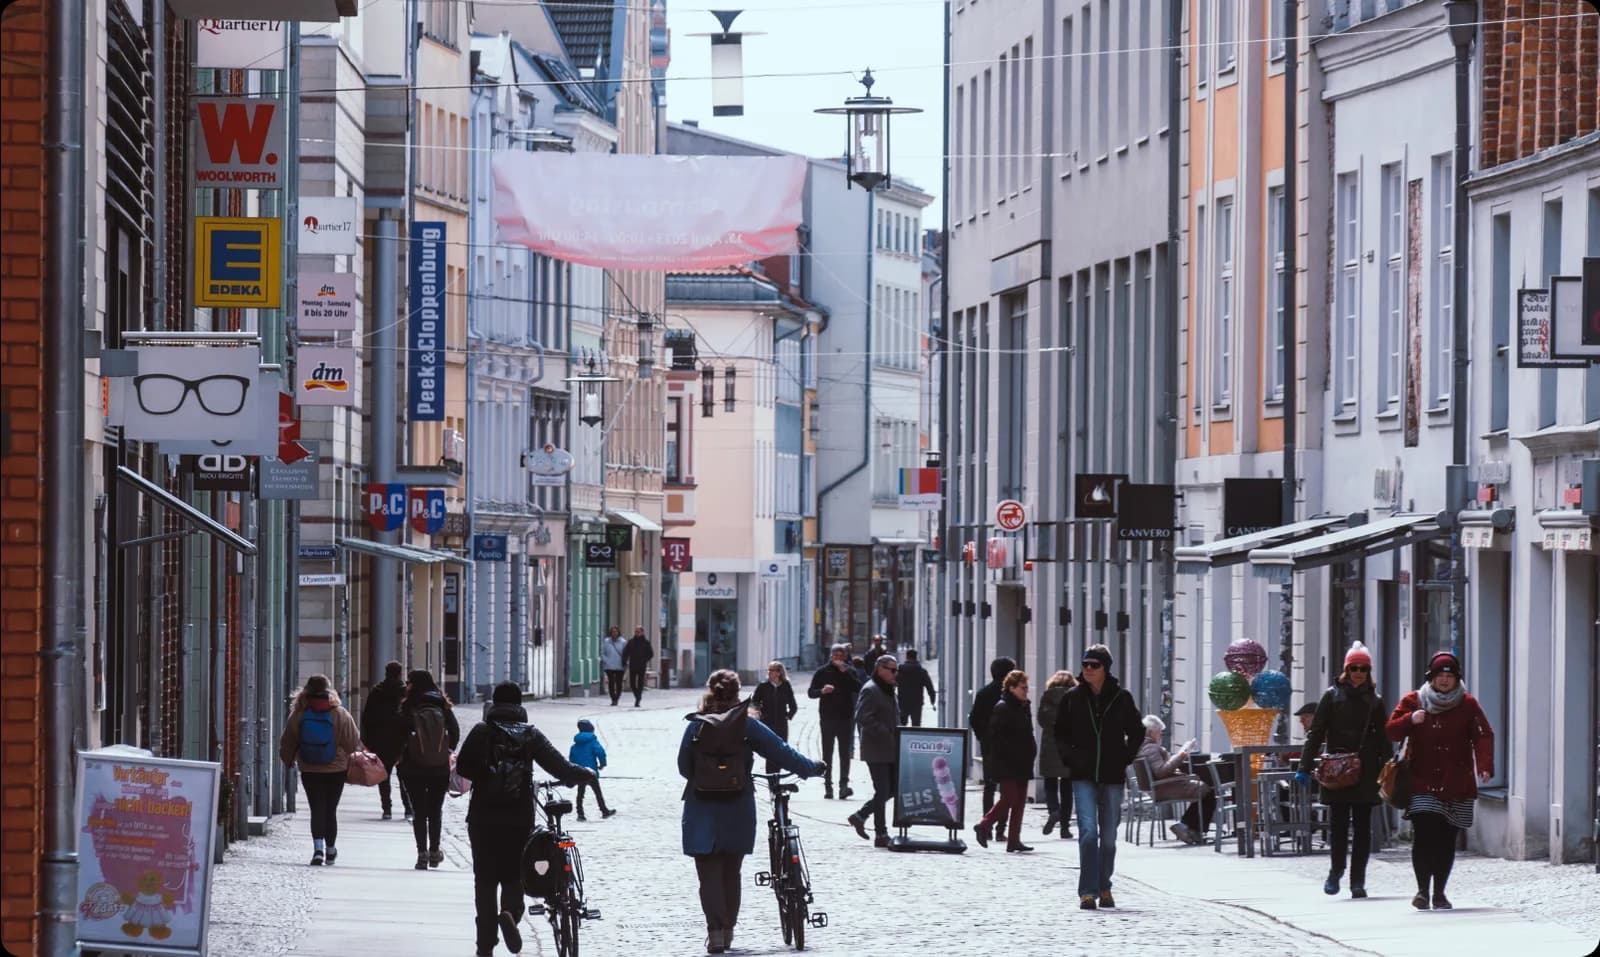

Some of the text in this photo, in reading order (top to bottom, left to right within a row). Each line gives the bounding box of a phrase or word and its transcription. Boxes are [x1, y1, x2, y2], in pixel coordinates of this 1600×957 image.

[195, 171, 276, 183] WOOLWORTH
[209, 285, 262, 296] EDEKA
[320, 284, 335, 292] dm
[302, 300, 323, 308] Montag
[327, 300, 351, 308] Samstag
[304, 309, 348, 317] 8 bis 20 Uhr
[311, 363, 344, 381] dm
[370, 493, 403, 516] P&C
[411, 498, 443, 519] P&C
[1120, 528, 1170, 538] CANVERO
[902, 789, 933, 807] EIS
